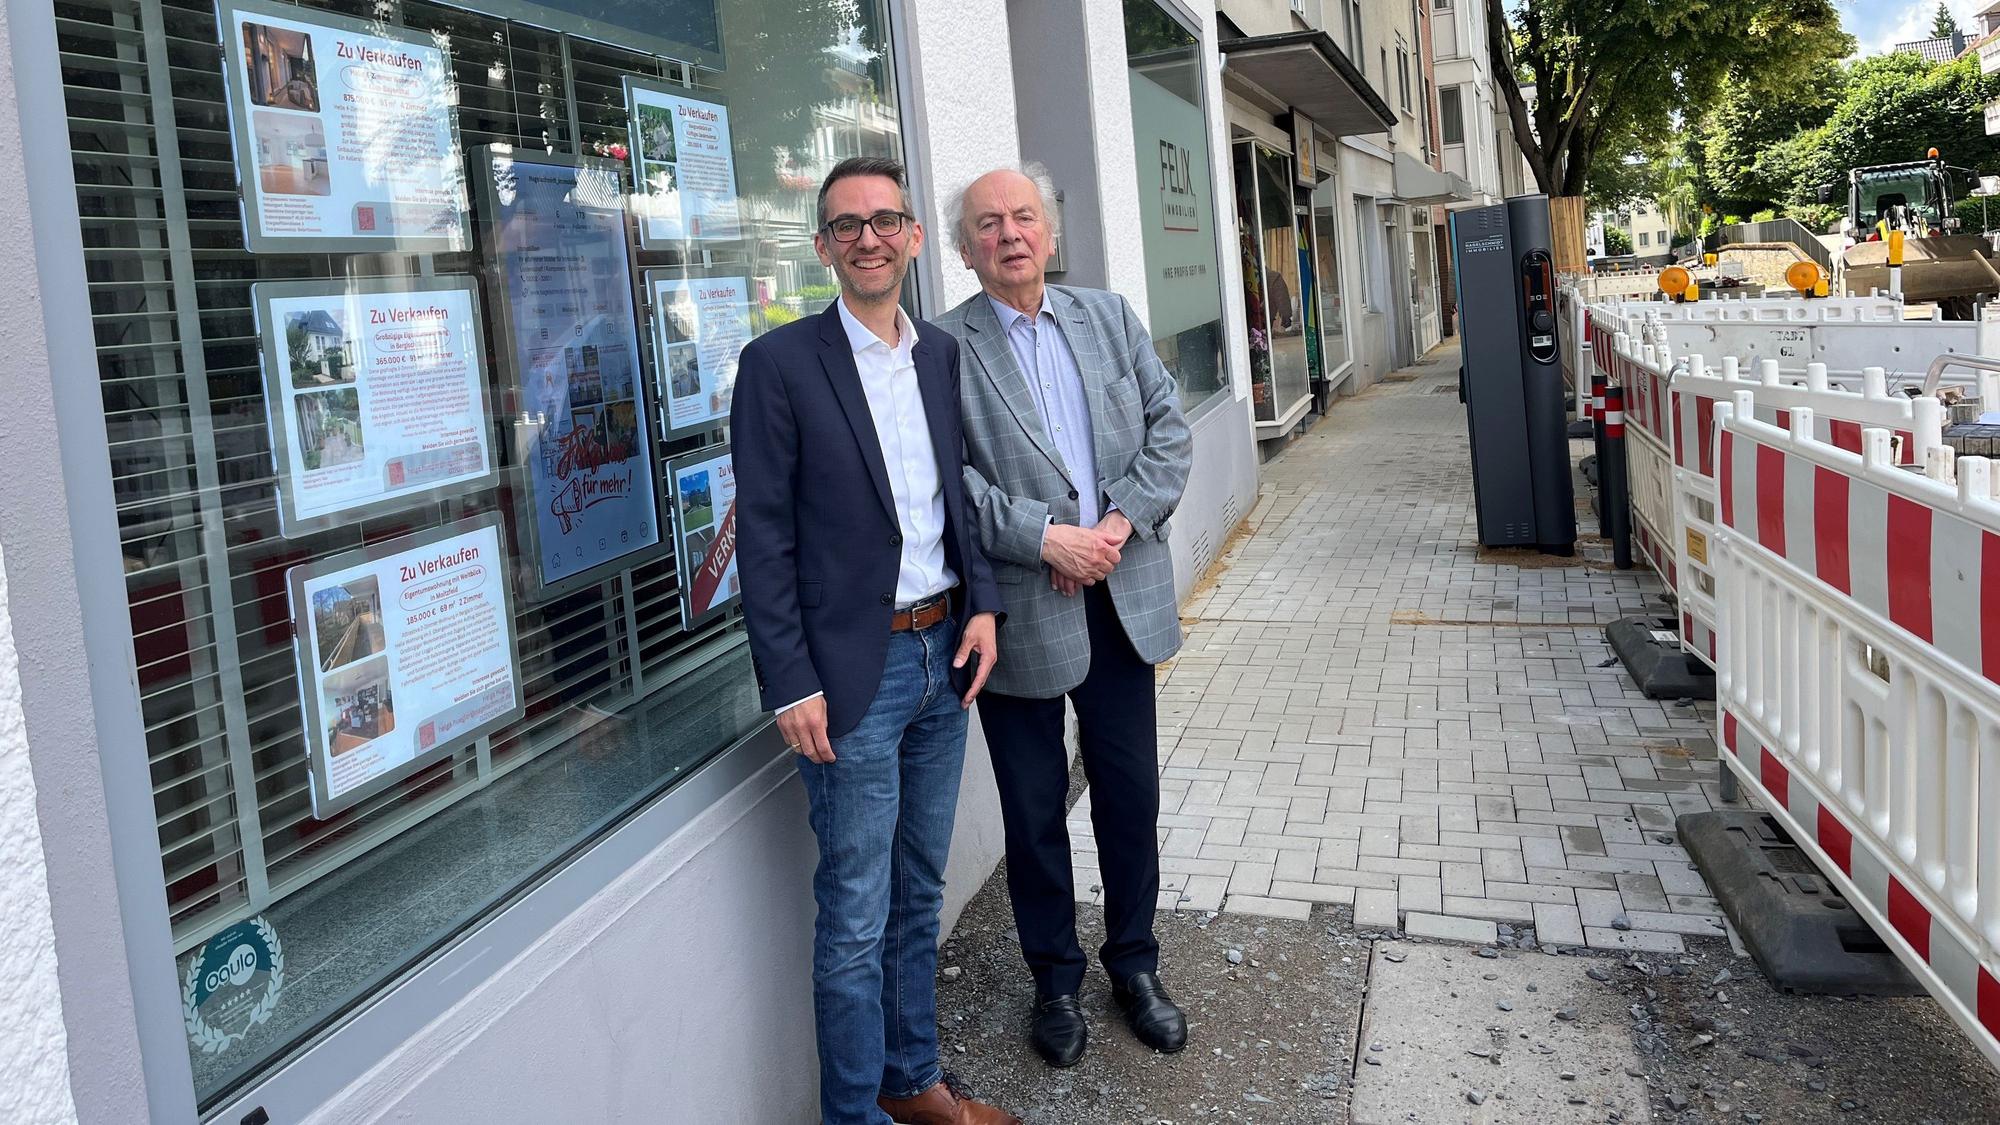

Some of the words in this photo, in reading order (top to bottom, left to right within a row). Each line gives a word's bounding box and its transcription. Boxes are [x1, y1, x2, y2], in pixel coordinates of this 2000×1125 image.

[336, 42, 353, 58] Zu
[357, 45, 422, 71] Verkaufen
[678, 104, 686, 116] Zu
[687, 106, 718, 122] Verkaufen
[1160, 139, 1193, 195] FELIX
[1164, 203, 1196, 219] IMMOBILIEN
[699, 289, 706, 299] Zu
[707, 286, 735, 300] Verkaufen
[370, 309, 385, 324] Zu
[388, 306, 448, 322] Verkaufen
[1770, 330, 1805, 341] TADT
[718, 466, 726, 478] Zu
[582, 474, 598, 500] für
[400, 566, 416, 582] Zu
[418, 547, 479, 575] Verkaufen
[404, 579, 452, 599] Eigentumswohnung
[406, 610, 431, 625] 185.000
[463, 592, 483, 604] Zimmer
